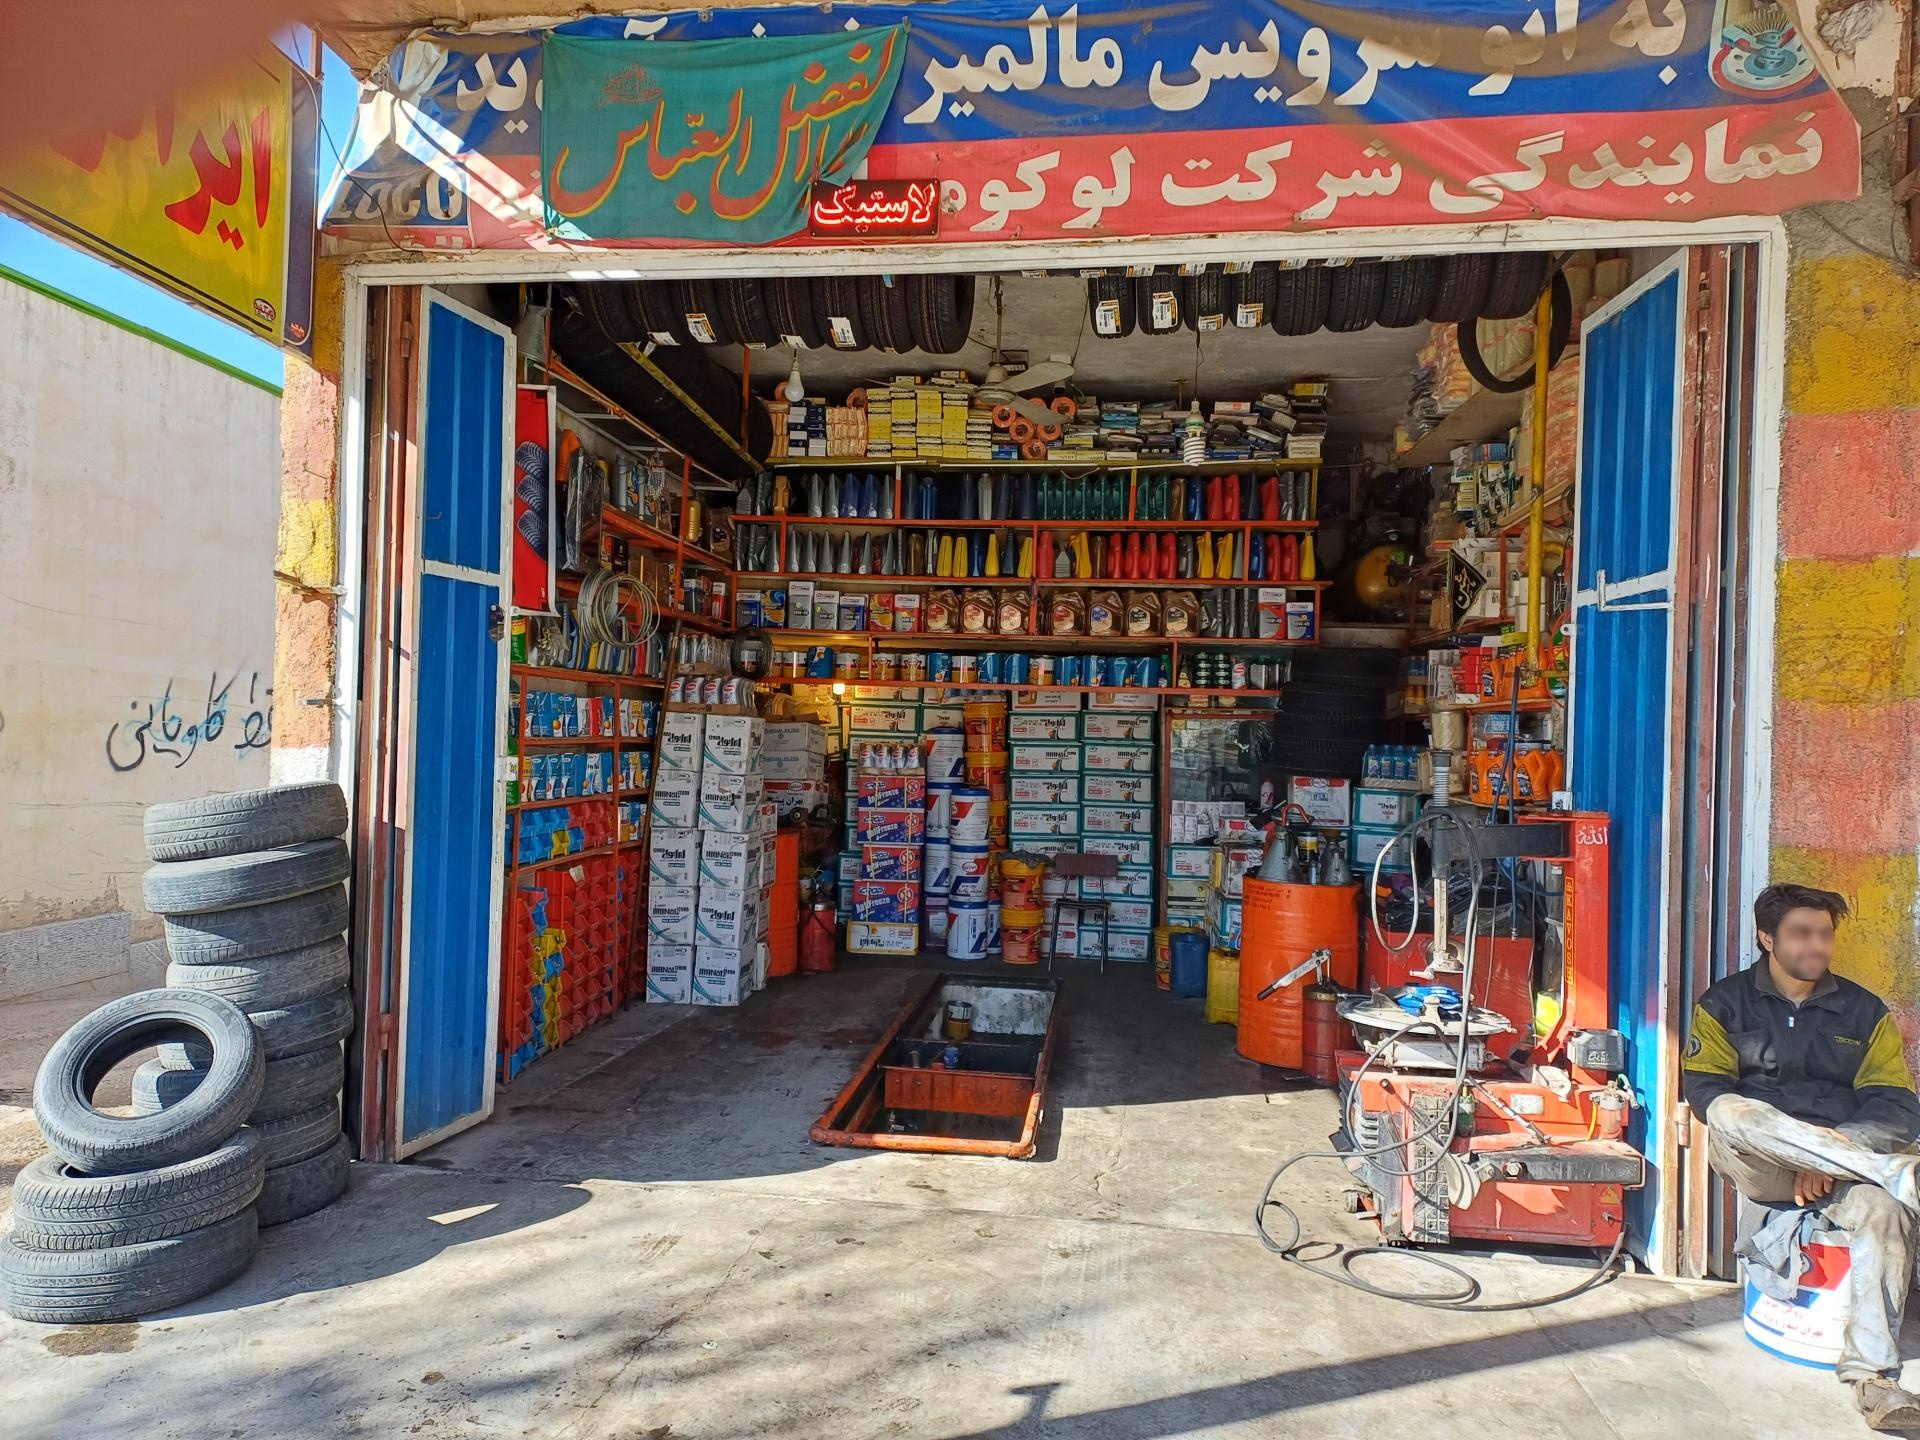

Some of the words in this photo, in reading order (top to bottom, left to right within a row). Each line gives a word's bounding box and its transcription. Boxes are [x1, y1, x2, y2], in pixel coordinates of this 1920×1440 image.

[902, 3, 1124, 125] مالمیر
[1148, 18, 1442, 111] سرویس
[814, 182, 937, 233] لاستیک
[1160, 139, 1402, 222] شرکت
[1429, 110, 1824, 214] نمایندگی
